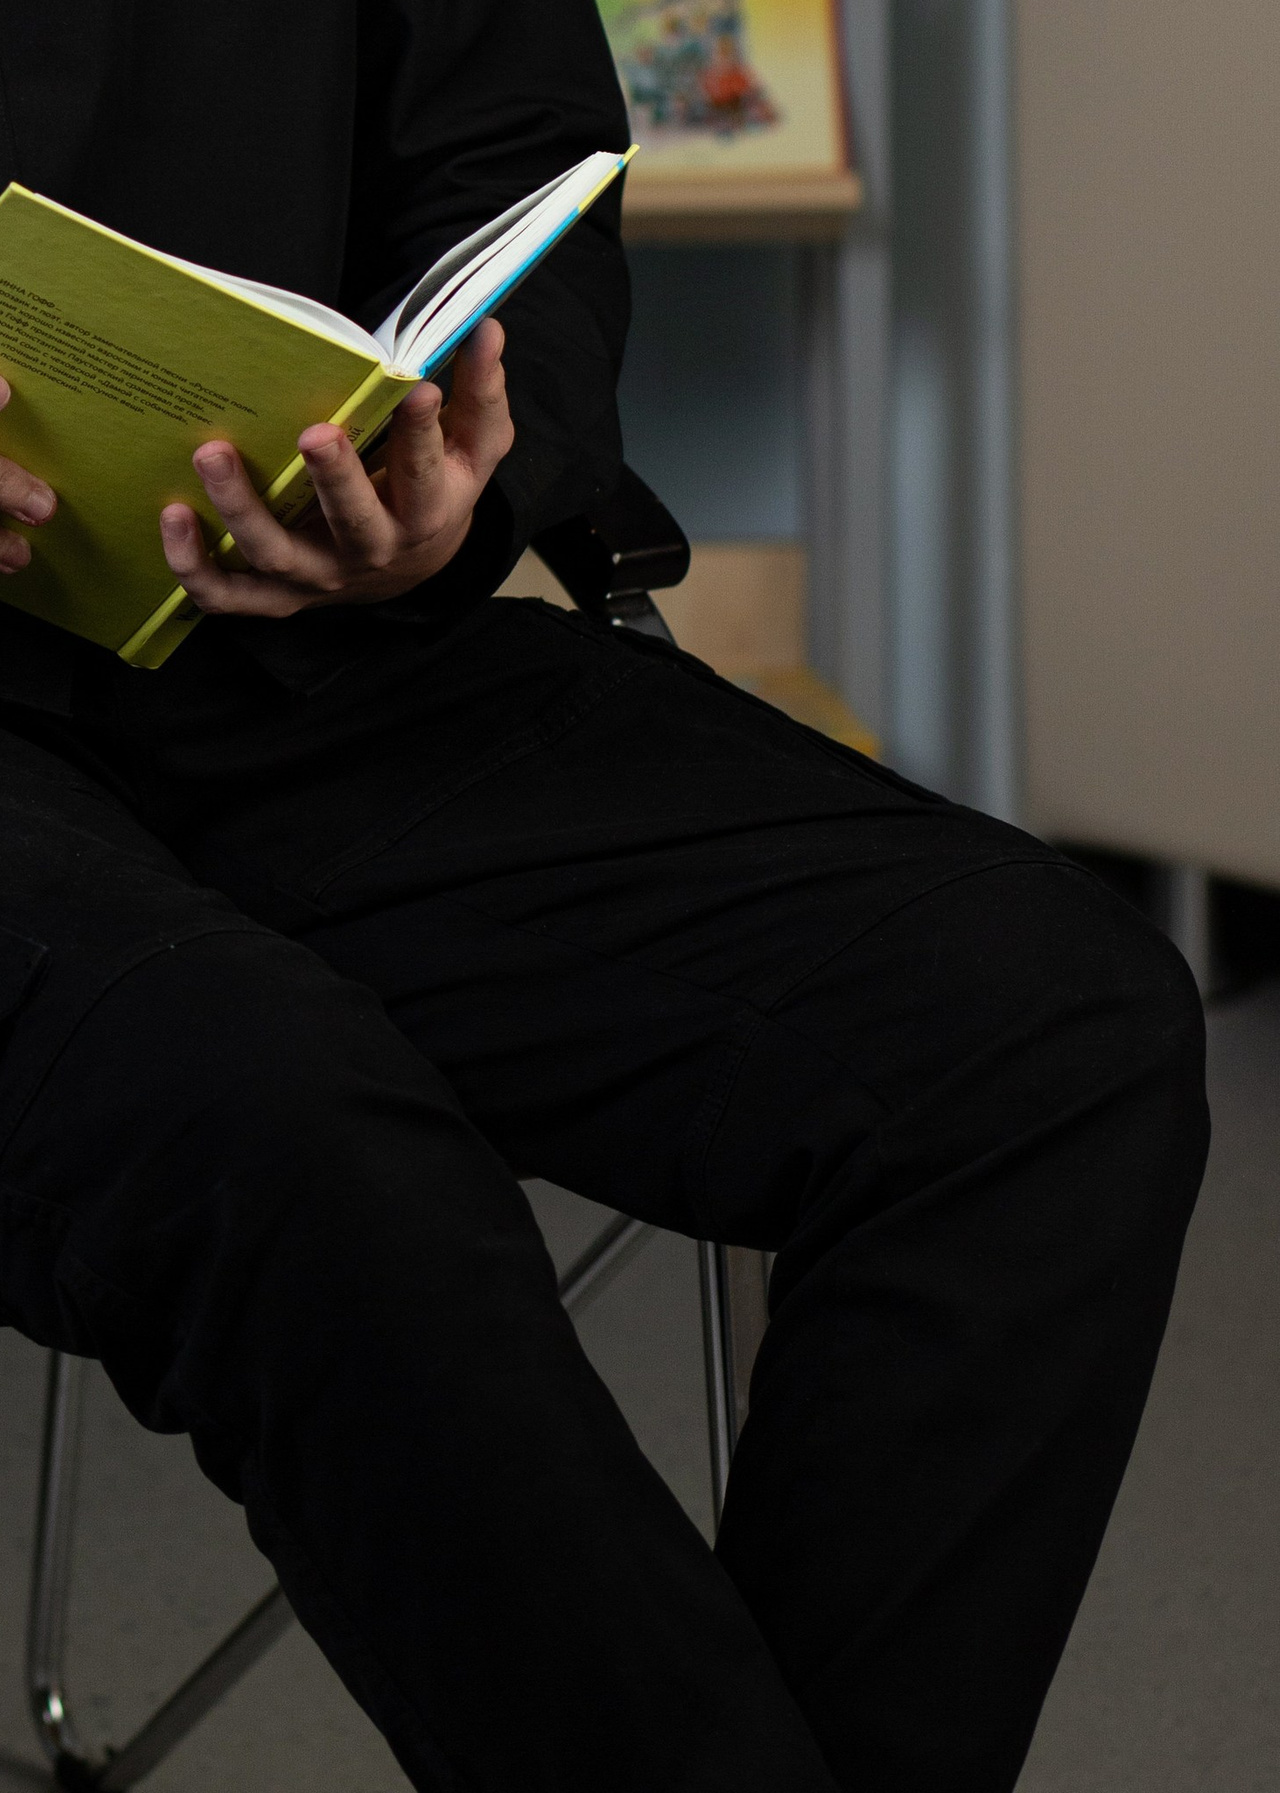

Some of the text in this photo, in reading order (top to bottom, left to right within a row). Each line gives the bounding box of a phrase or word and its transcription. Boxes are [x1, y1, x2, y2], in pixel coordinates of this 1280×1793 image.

[27, 292, 55, 308] ГОФФ
[0, 300, 18, 311] имя
[18, 310, 54, 329] хорошо
[55, 327, 96, 349] известно
[97, 347, 142, 371] взрослым
[150, 373, 178, 388] юным
[5, 312, 29, 327] Гофф
[30, 326, 86, 355] признанный
[87, 353, 119, 371] мастер
[120, 369, 174, 397] лирической
[15, 327, 67, 356] Константин
[67, 353, 124, 383] Паустовский
[125, 382, 173, 406] сравнивал
[50, 356, 97, 380] чеховской
[64, 321, 91, 336] автор
[92, 335, 160, 369] замечательной
[160, 367, 188, 383] песни
[49, 365, 81, 383] тонкий
[80, 381, 118, 401] рисунок
